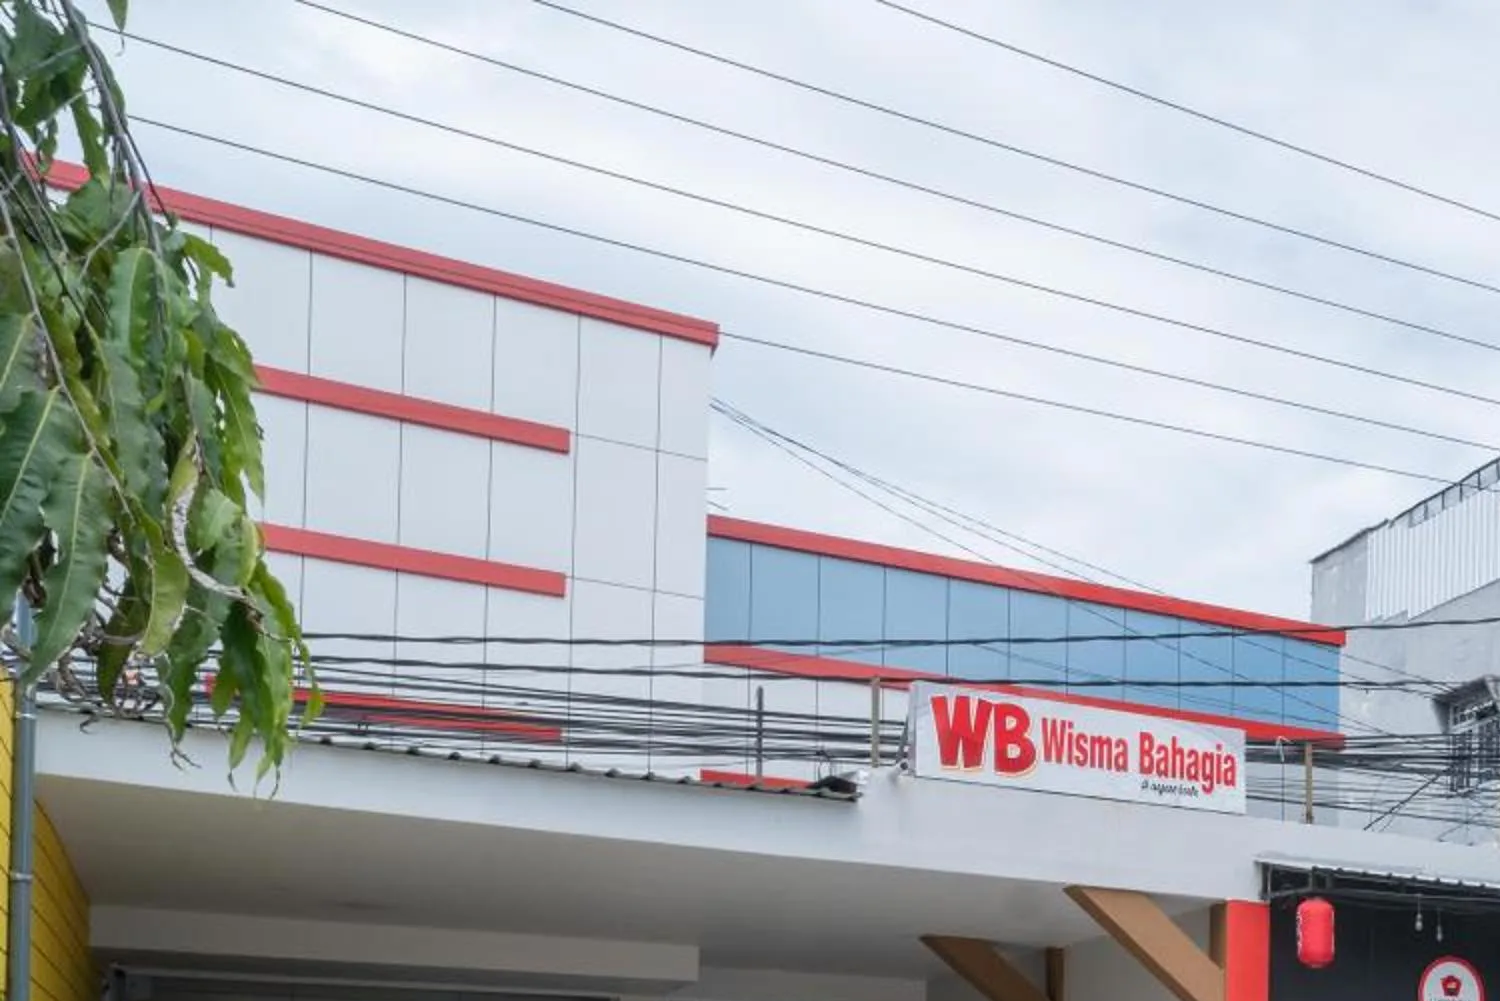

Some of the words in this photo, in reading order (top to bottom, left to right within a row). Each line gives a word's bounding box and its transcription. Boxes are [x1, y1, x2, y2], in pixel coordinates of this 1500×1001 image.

[931, 696, 1036, 776] WB
[1041, 717, 1129, 773] Wisma
[1139, 732, 1237, 795] Bahagia
